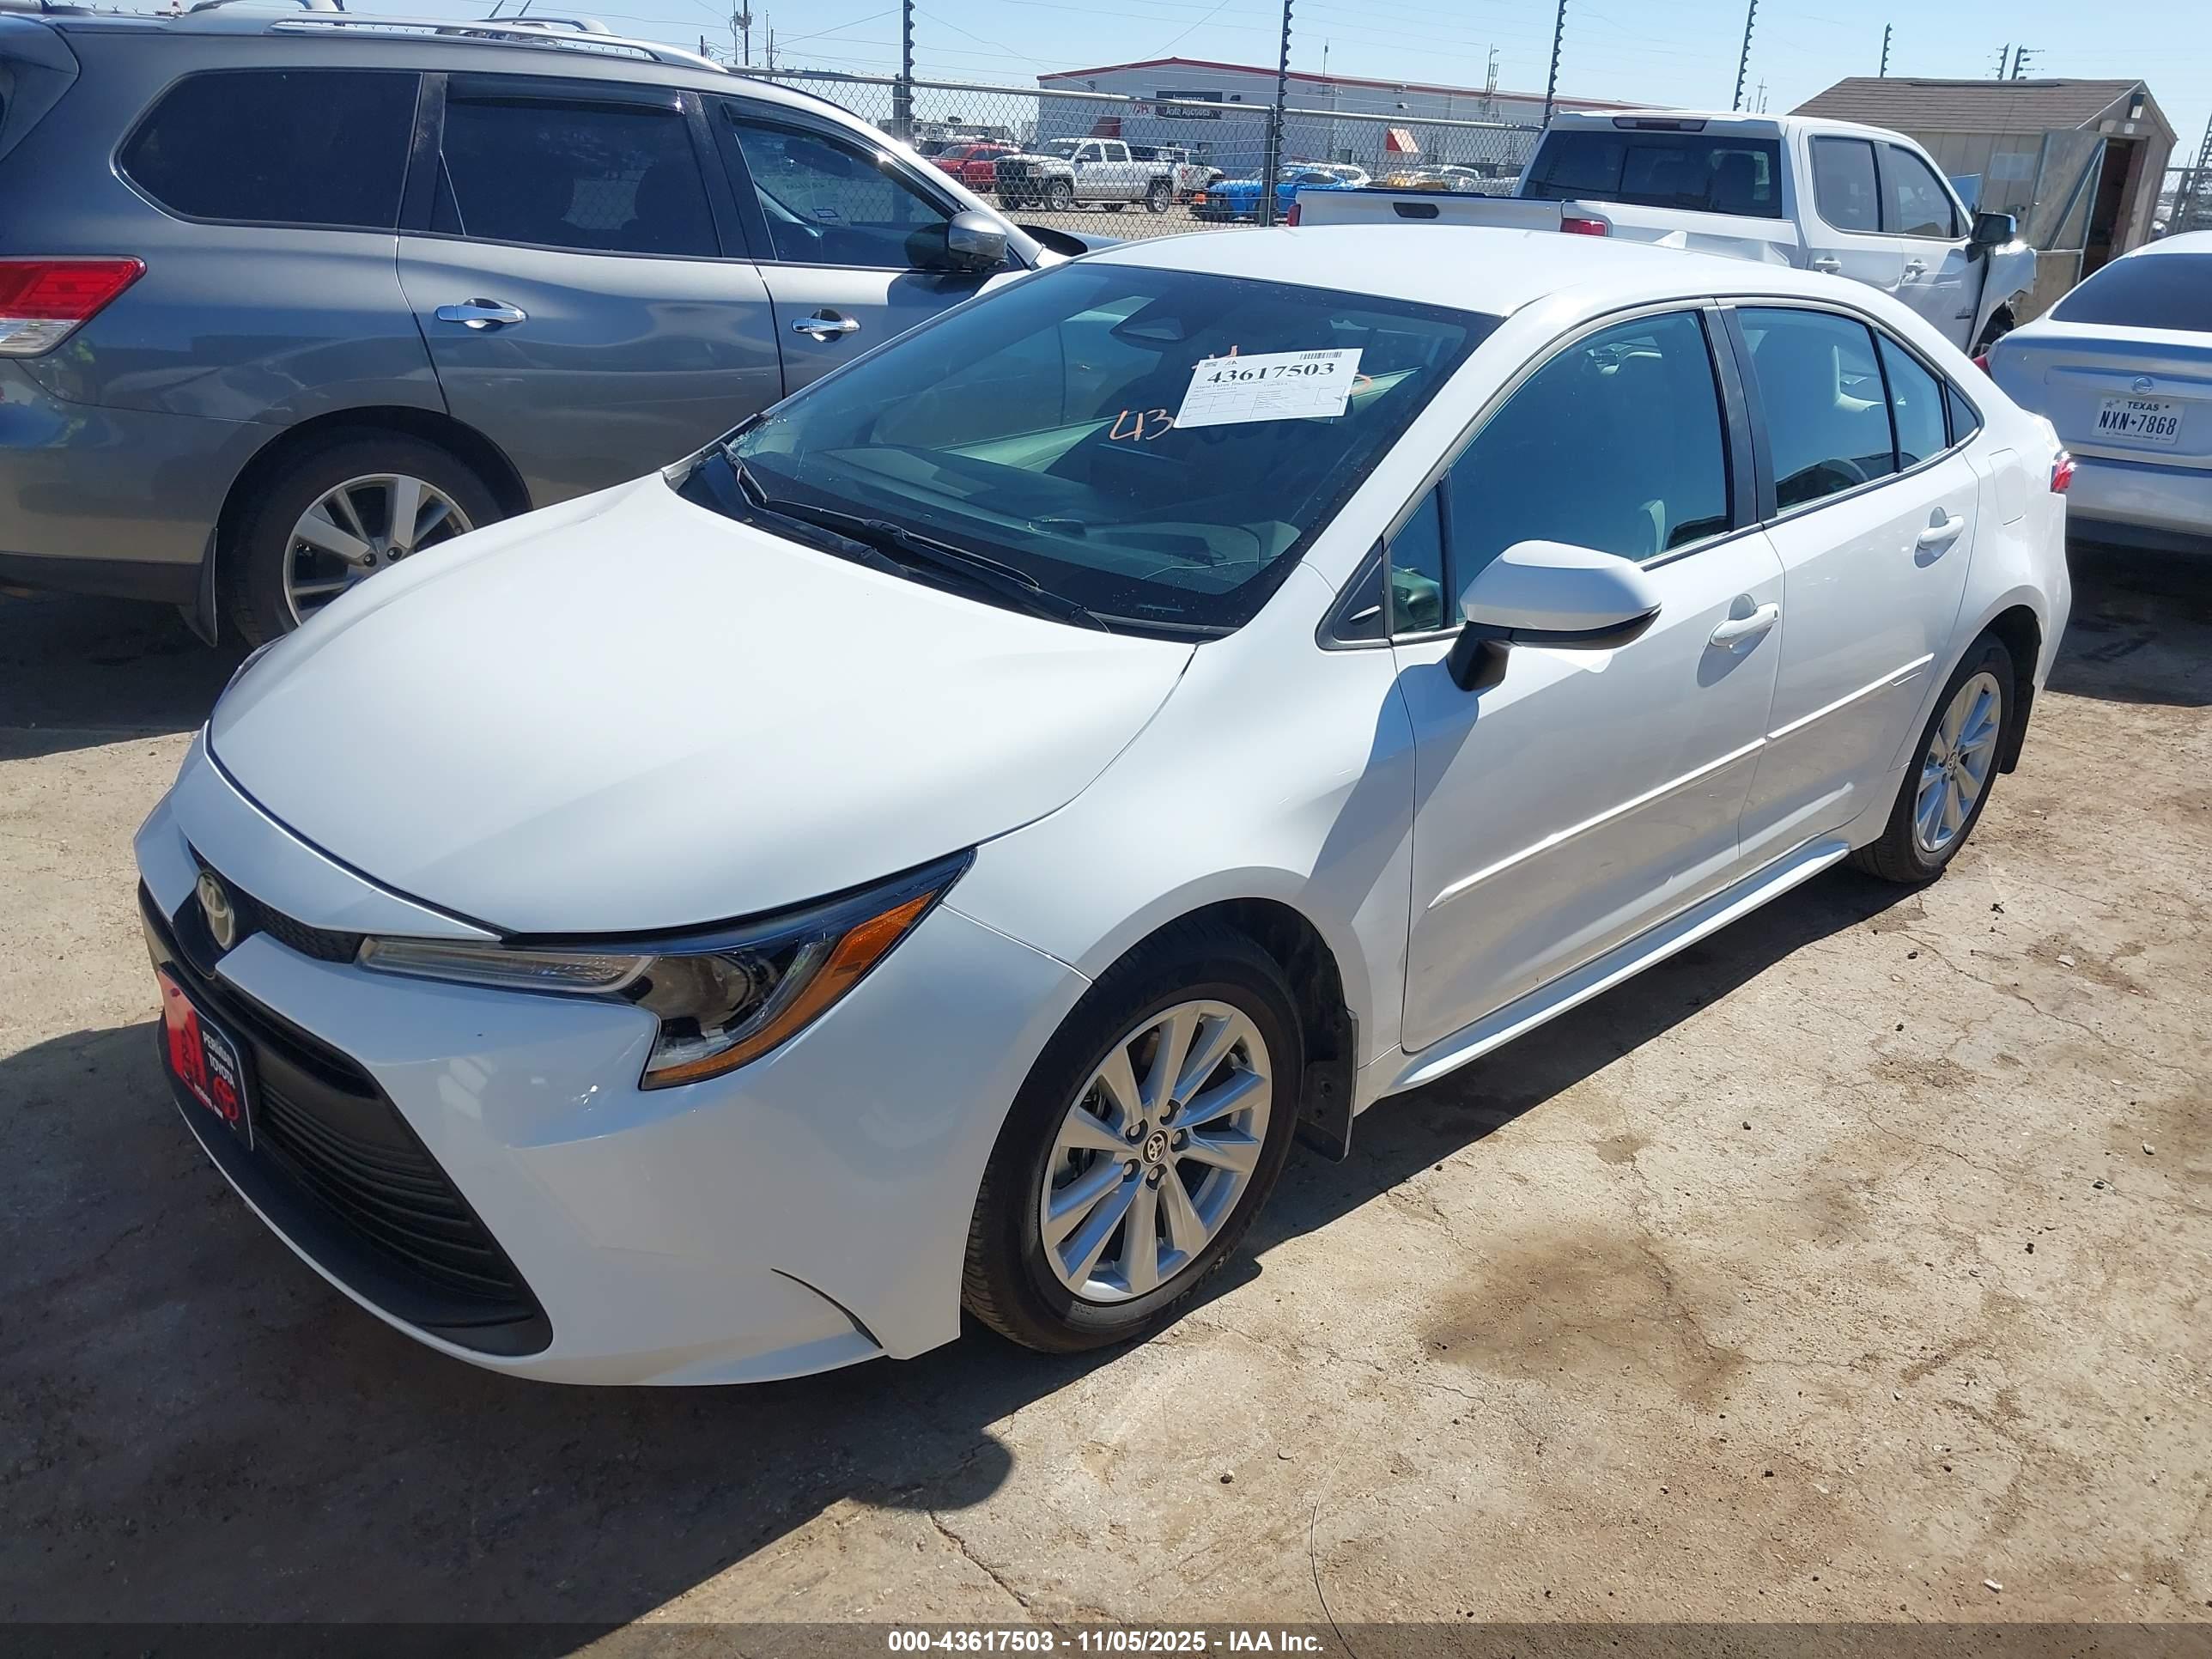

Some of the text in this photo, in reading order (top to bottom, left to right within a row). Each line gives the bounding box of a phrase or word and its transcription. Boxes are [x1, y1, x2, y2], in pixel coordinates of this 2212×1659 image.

[1206, 362, 1334, 384] 43617503
[2128, 401, 2160, 412] TEXAS
[207, 1052, 236, 1090] TOYOTA
